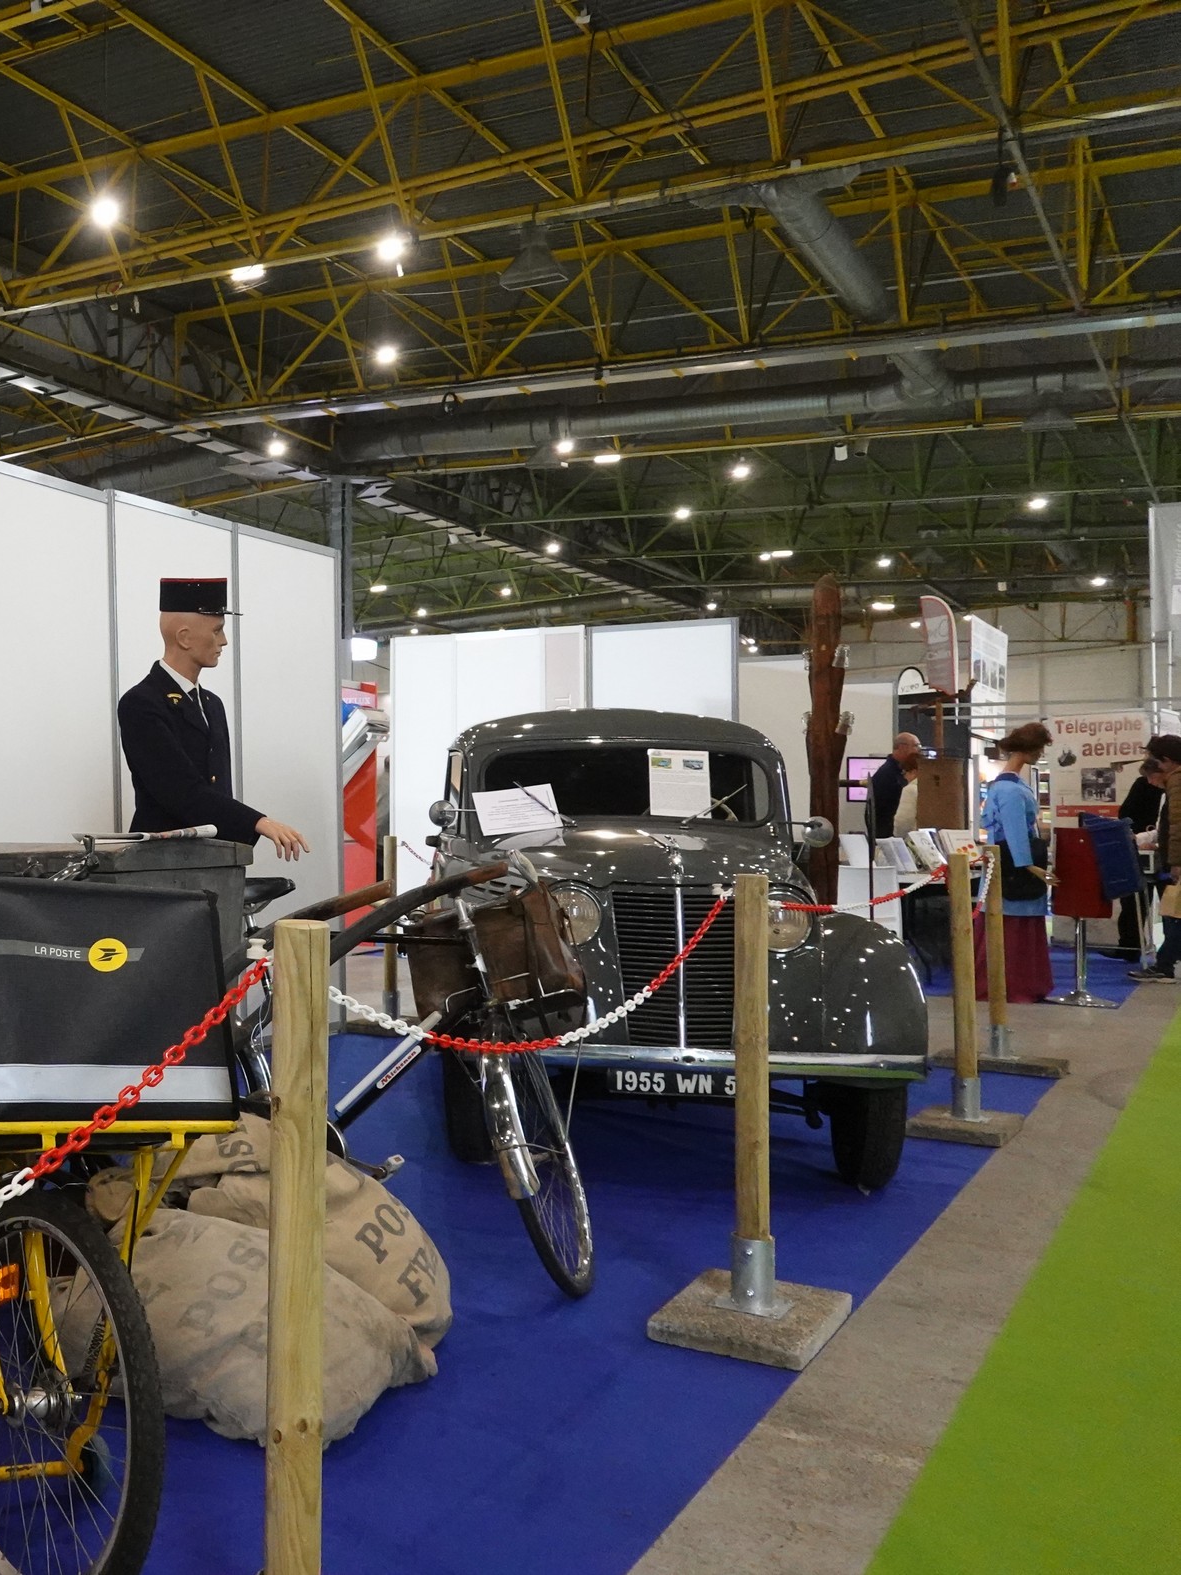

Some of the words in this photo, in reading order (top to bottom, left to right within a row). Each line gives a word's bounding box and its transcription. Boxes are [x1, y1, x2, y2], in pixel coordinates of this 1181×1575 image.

[1055, 717, 1143, 736] Télégraphe
[34, 945, 47, 955] LA
[49, 947, 81, 959] POSTE
[616, 1070, 666, 1093] 1955
[676, 1073, 712, 1095] WN
